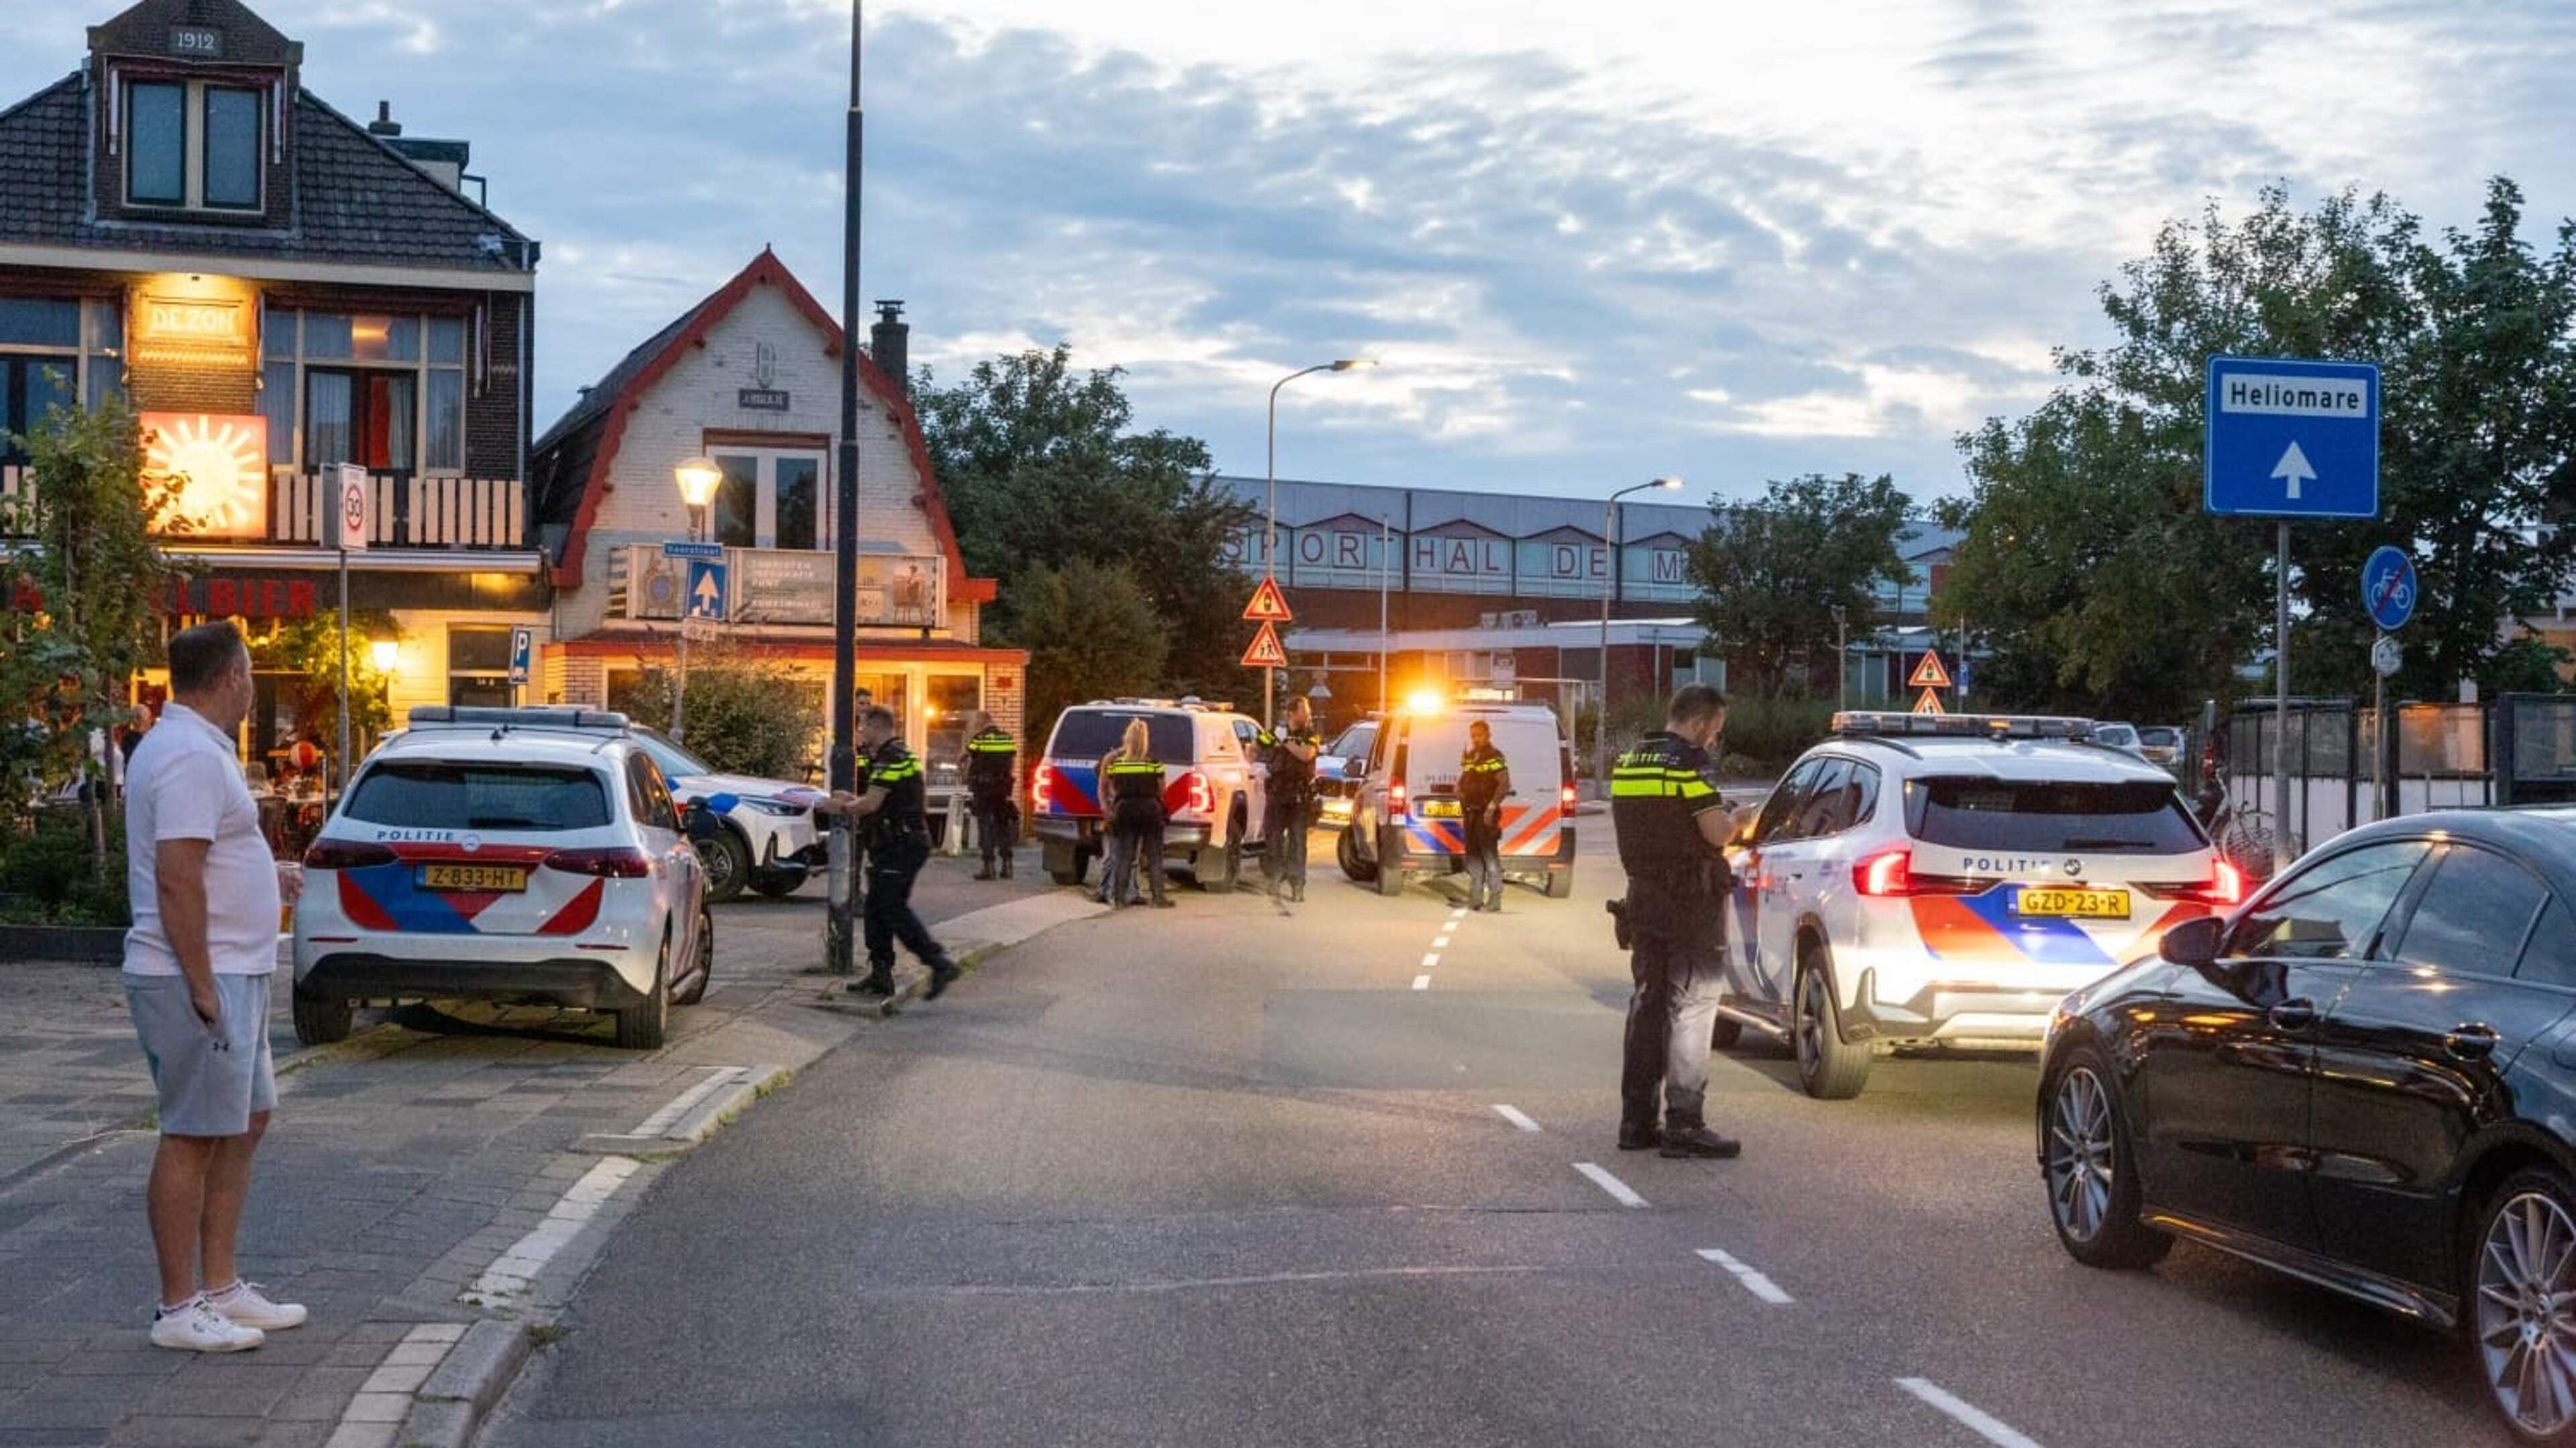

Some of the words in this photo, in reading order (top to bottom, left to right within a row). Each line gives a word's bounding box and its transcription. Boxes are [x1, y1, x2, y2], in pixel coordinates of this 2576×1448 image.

[177, 32, 214, 50] 1912
[151, 307, 183, 331] DE
[189, 308, 236, 334] ZON
[2231, 382, 2360, 409] Heliomare
[209, 578, 315, 617] BIER
[377, 830, 454, 841] POLITIE
[431, 868, 518, 886] Z-833-HT
[2025, 892, 2121, 912] GZD-23-R
